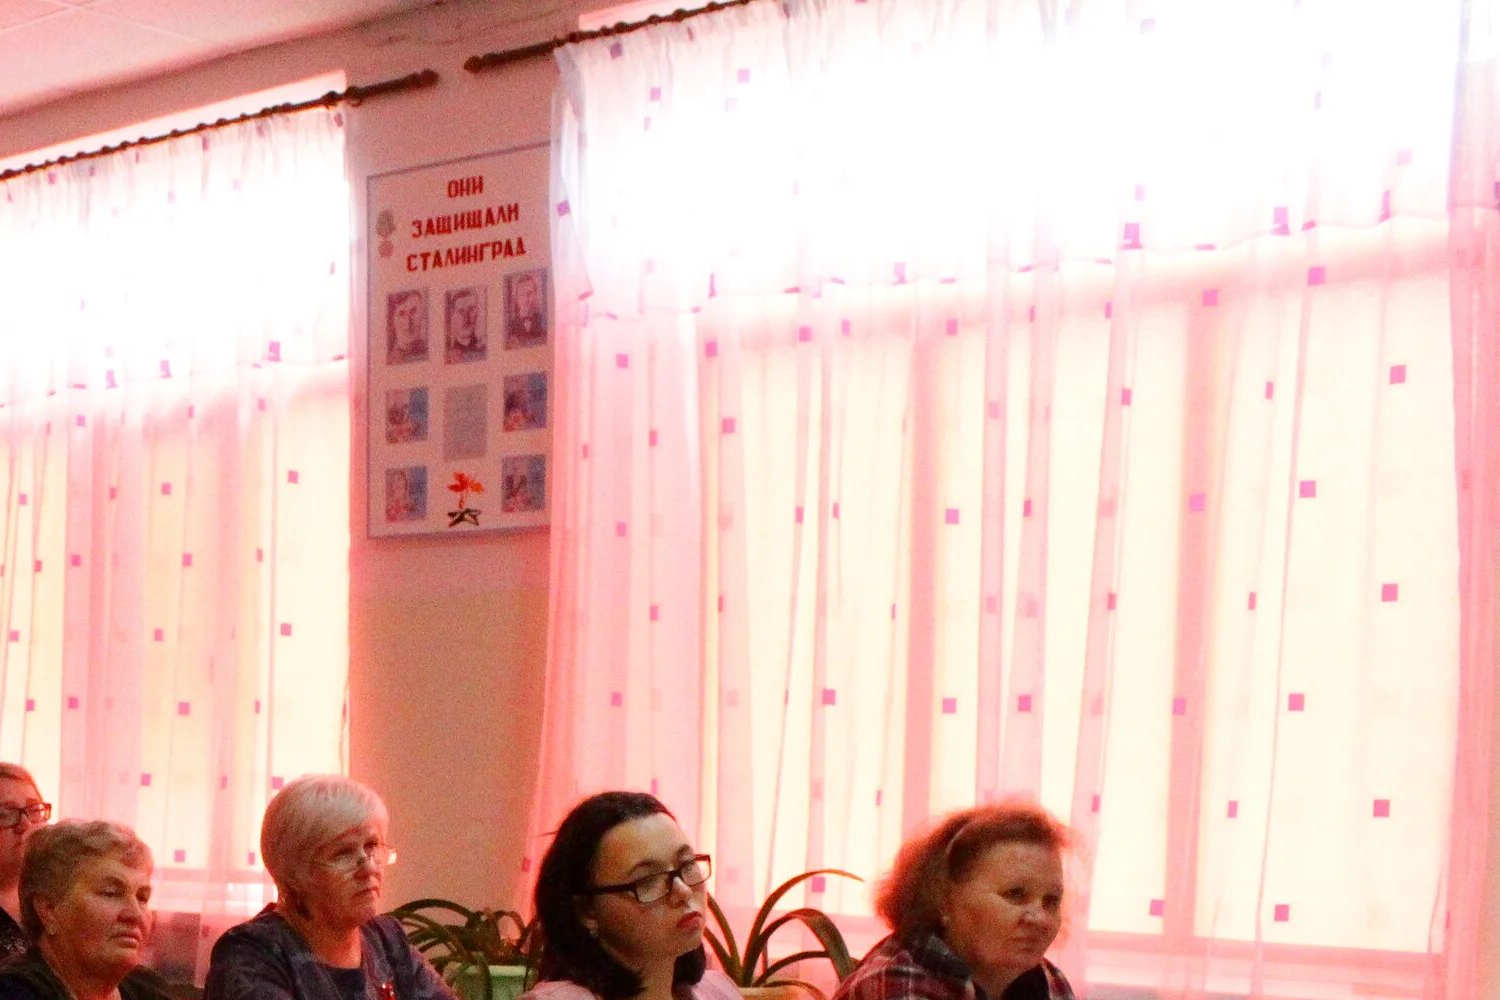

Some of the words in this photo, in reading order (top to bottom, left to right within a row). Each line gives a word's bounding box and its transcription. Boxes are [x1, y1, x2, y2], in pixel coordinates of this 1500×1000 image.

[447, 175, 484, 199] ОНИ
[412, 202, 520, 239] ЗАЩИЩАЛИ
[406, 236, 527, 272] СТАЛИНГРАД
